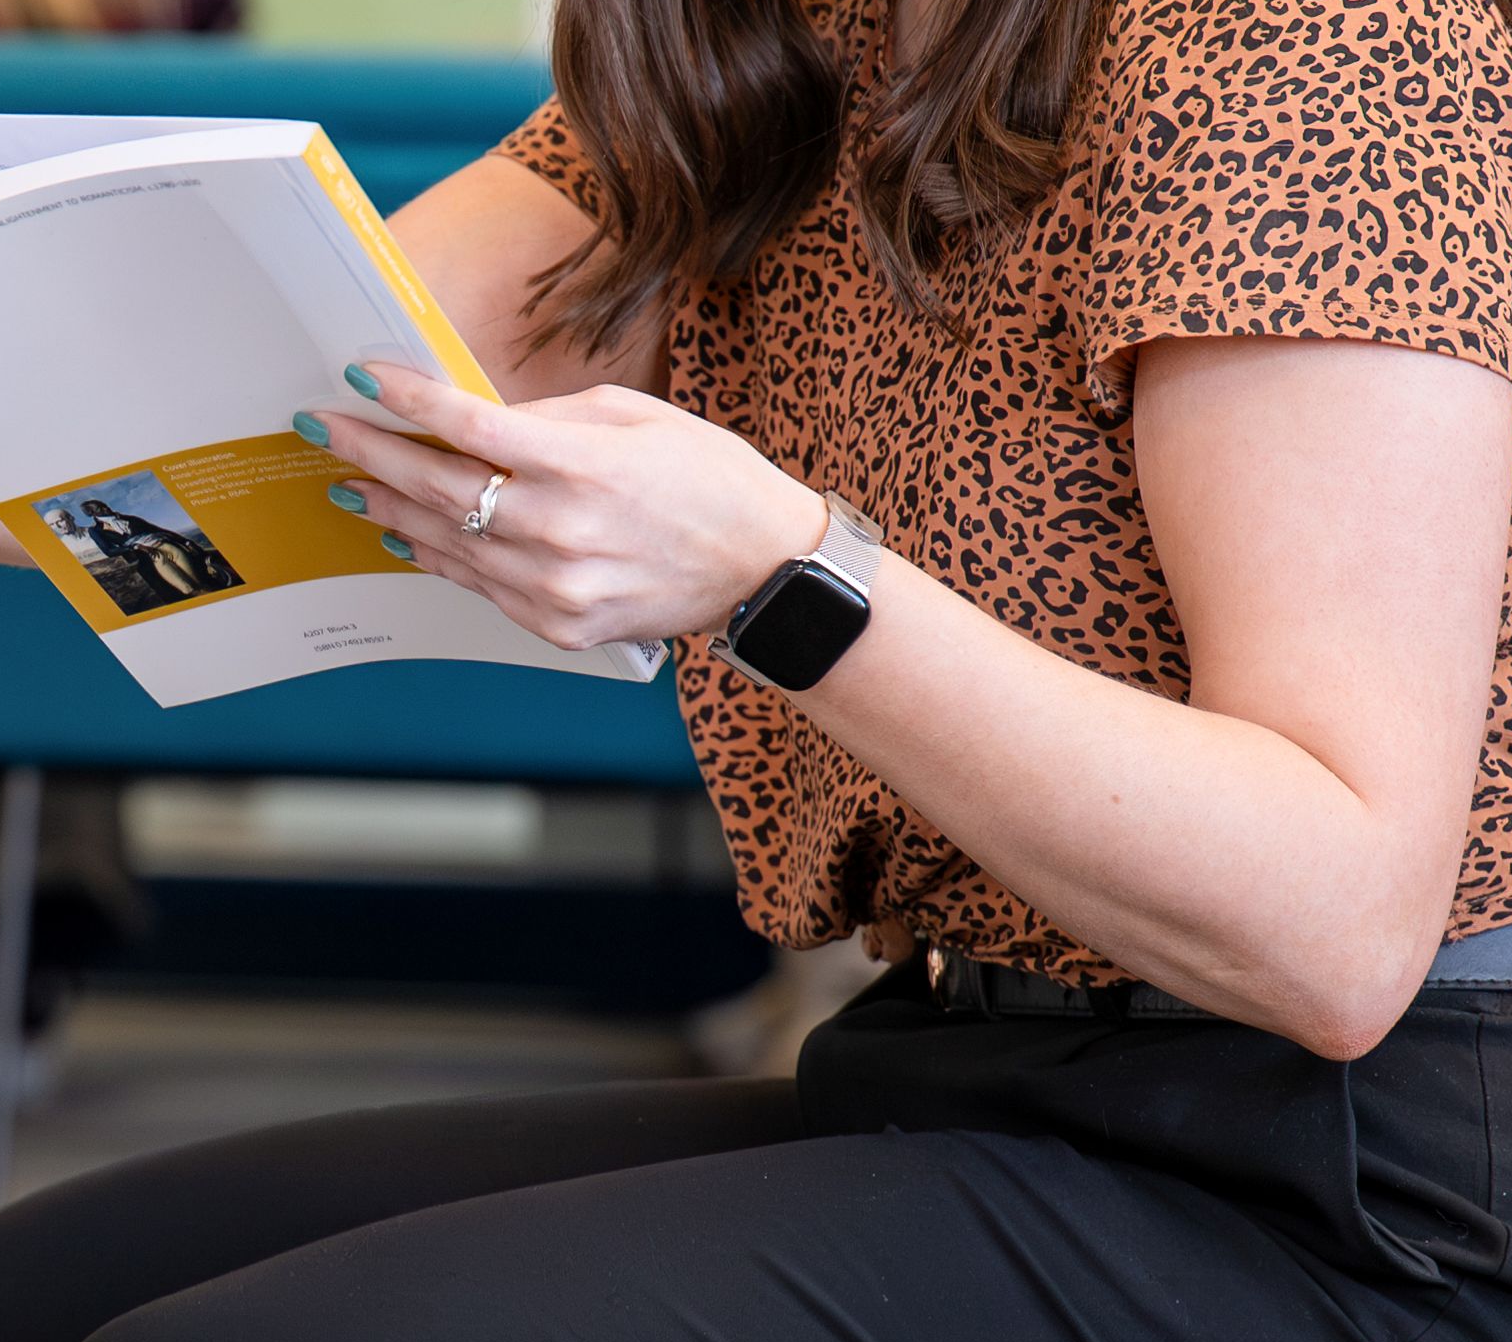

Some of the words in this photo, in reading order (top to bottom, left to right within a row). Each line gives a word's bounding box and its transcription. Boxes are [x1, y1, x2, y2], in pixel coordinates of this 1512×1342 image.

[65, 198, 79, 208] TO
[80, 185, 146, 204] ROMANTICISM,
[162, 462, 187, 473] Cover
[303, 628, 324, 639] A207
[313, 642, 336, 652] ISBN
[644, 642, 661, 664] WOL
